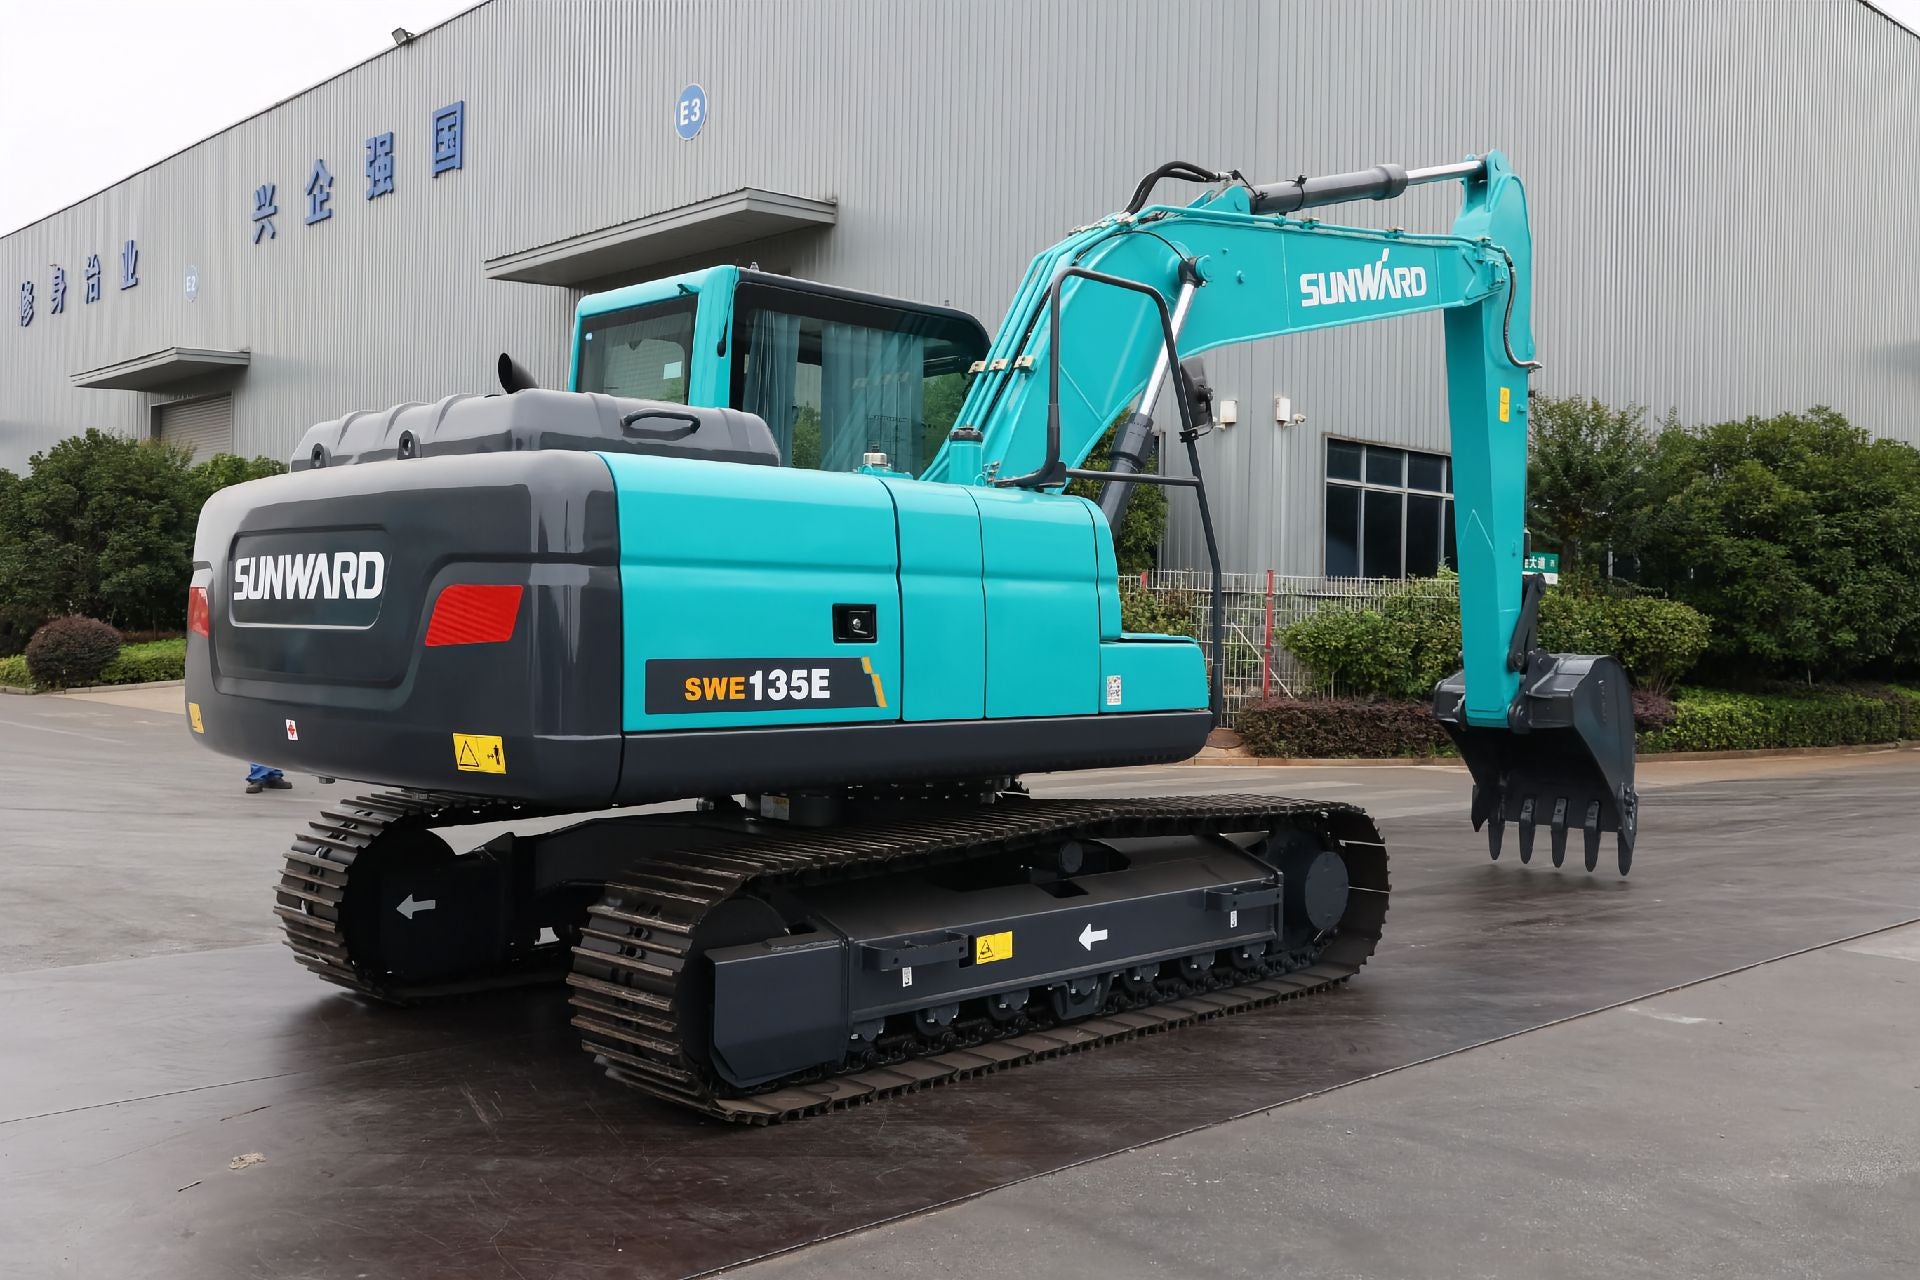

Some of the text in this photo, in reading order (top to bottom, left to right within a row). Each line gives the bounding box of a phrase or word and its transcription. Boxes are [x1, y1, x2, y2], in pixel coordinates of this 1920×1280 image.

[680, 98, 700, 126] E3
[252, 100, 464, 245] 兴企强国
[186, 275, 196, 292] E2
[1300, 248, 1427, 307] SUNWARD
[233, 551, 385, 600] SUNWARD
